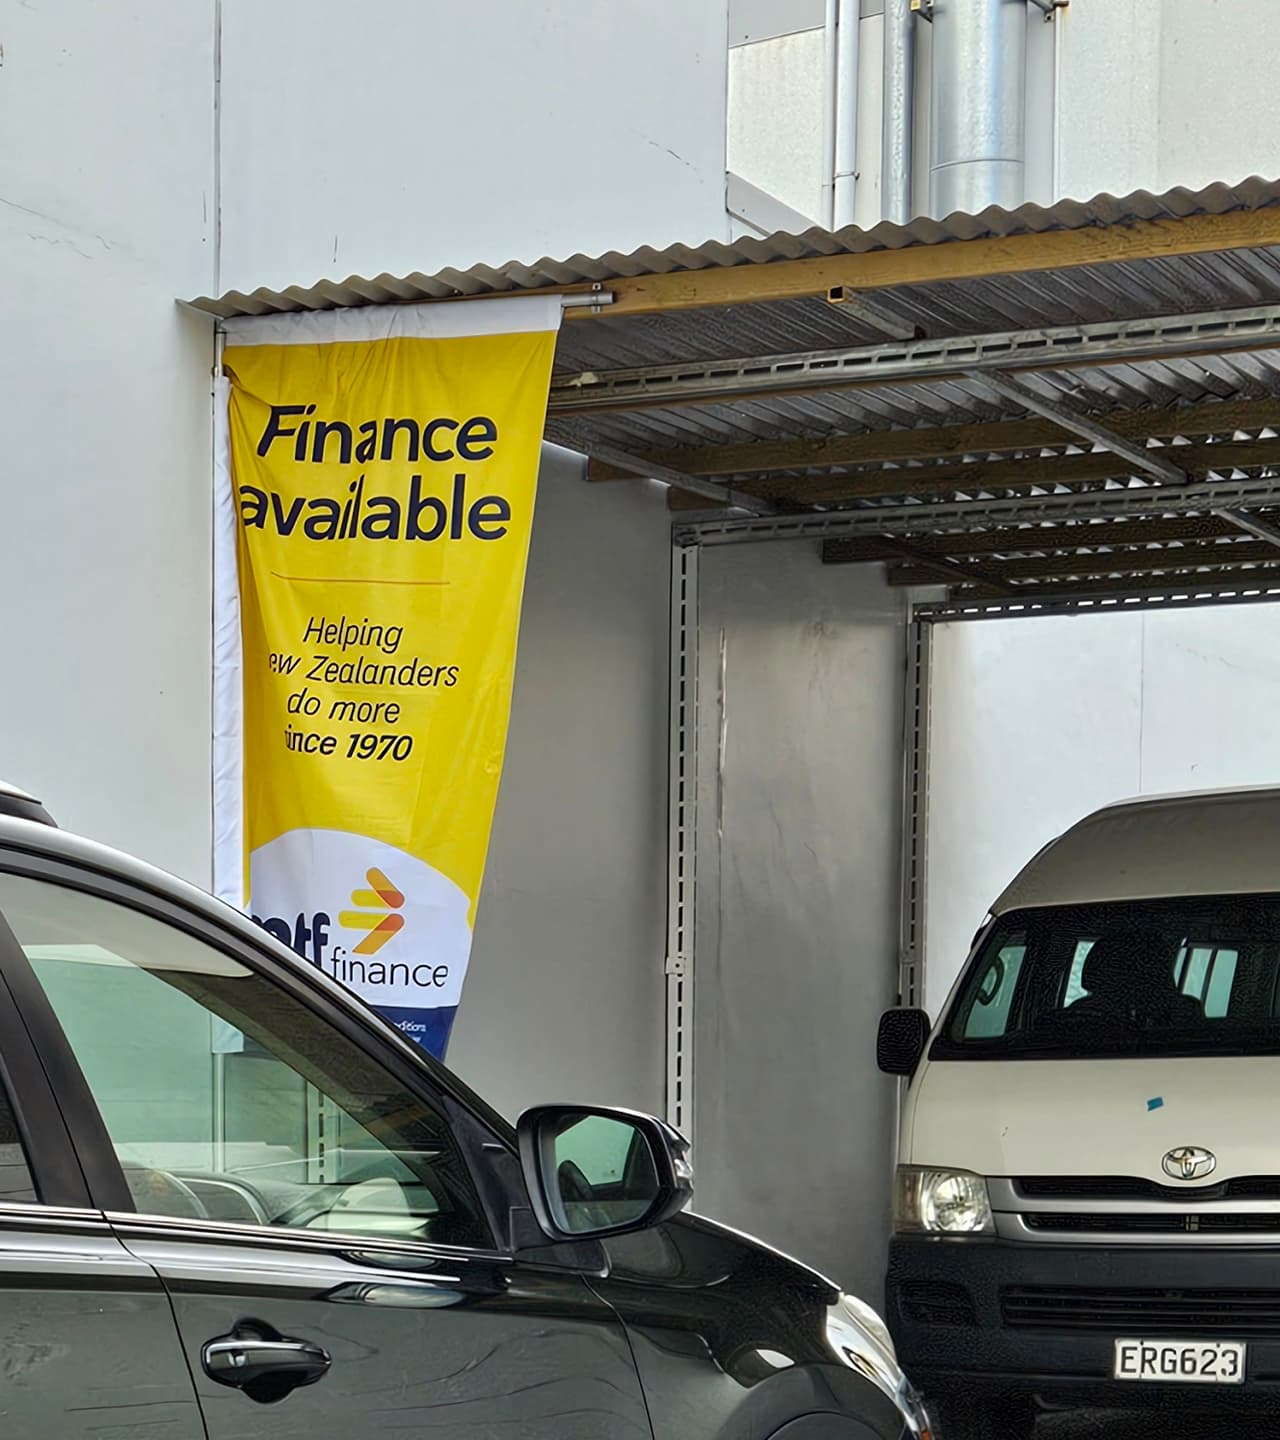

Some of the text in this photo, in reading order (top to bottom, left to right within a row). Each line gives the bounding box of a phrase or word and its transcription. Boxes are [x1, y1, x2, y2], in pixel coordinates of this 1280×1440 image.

[256, 403, 499, 464] Finance
[239, 473, 512, 542] available
[302, 615, 404, 654] Helping
[269, 652, 460, 687] ew Zealanders
[287, 687, 401, 724] do more
[284, 724, 414, 761] ince 1970
[330, 946, 449, 989] finance
[1120, 1346, 1239, 1377] ERG623
